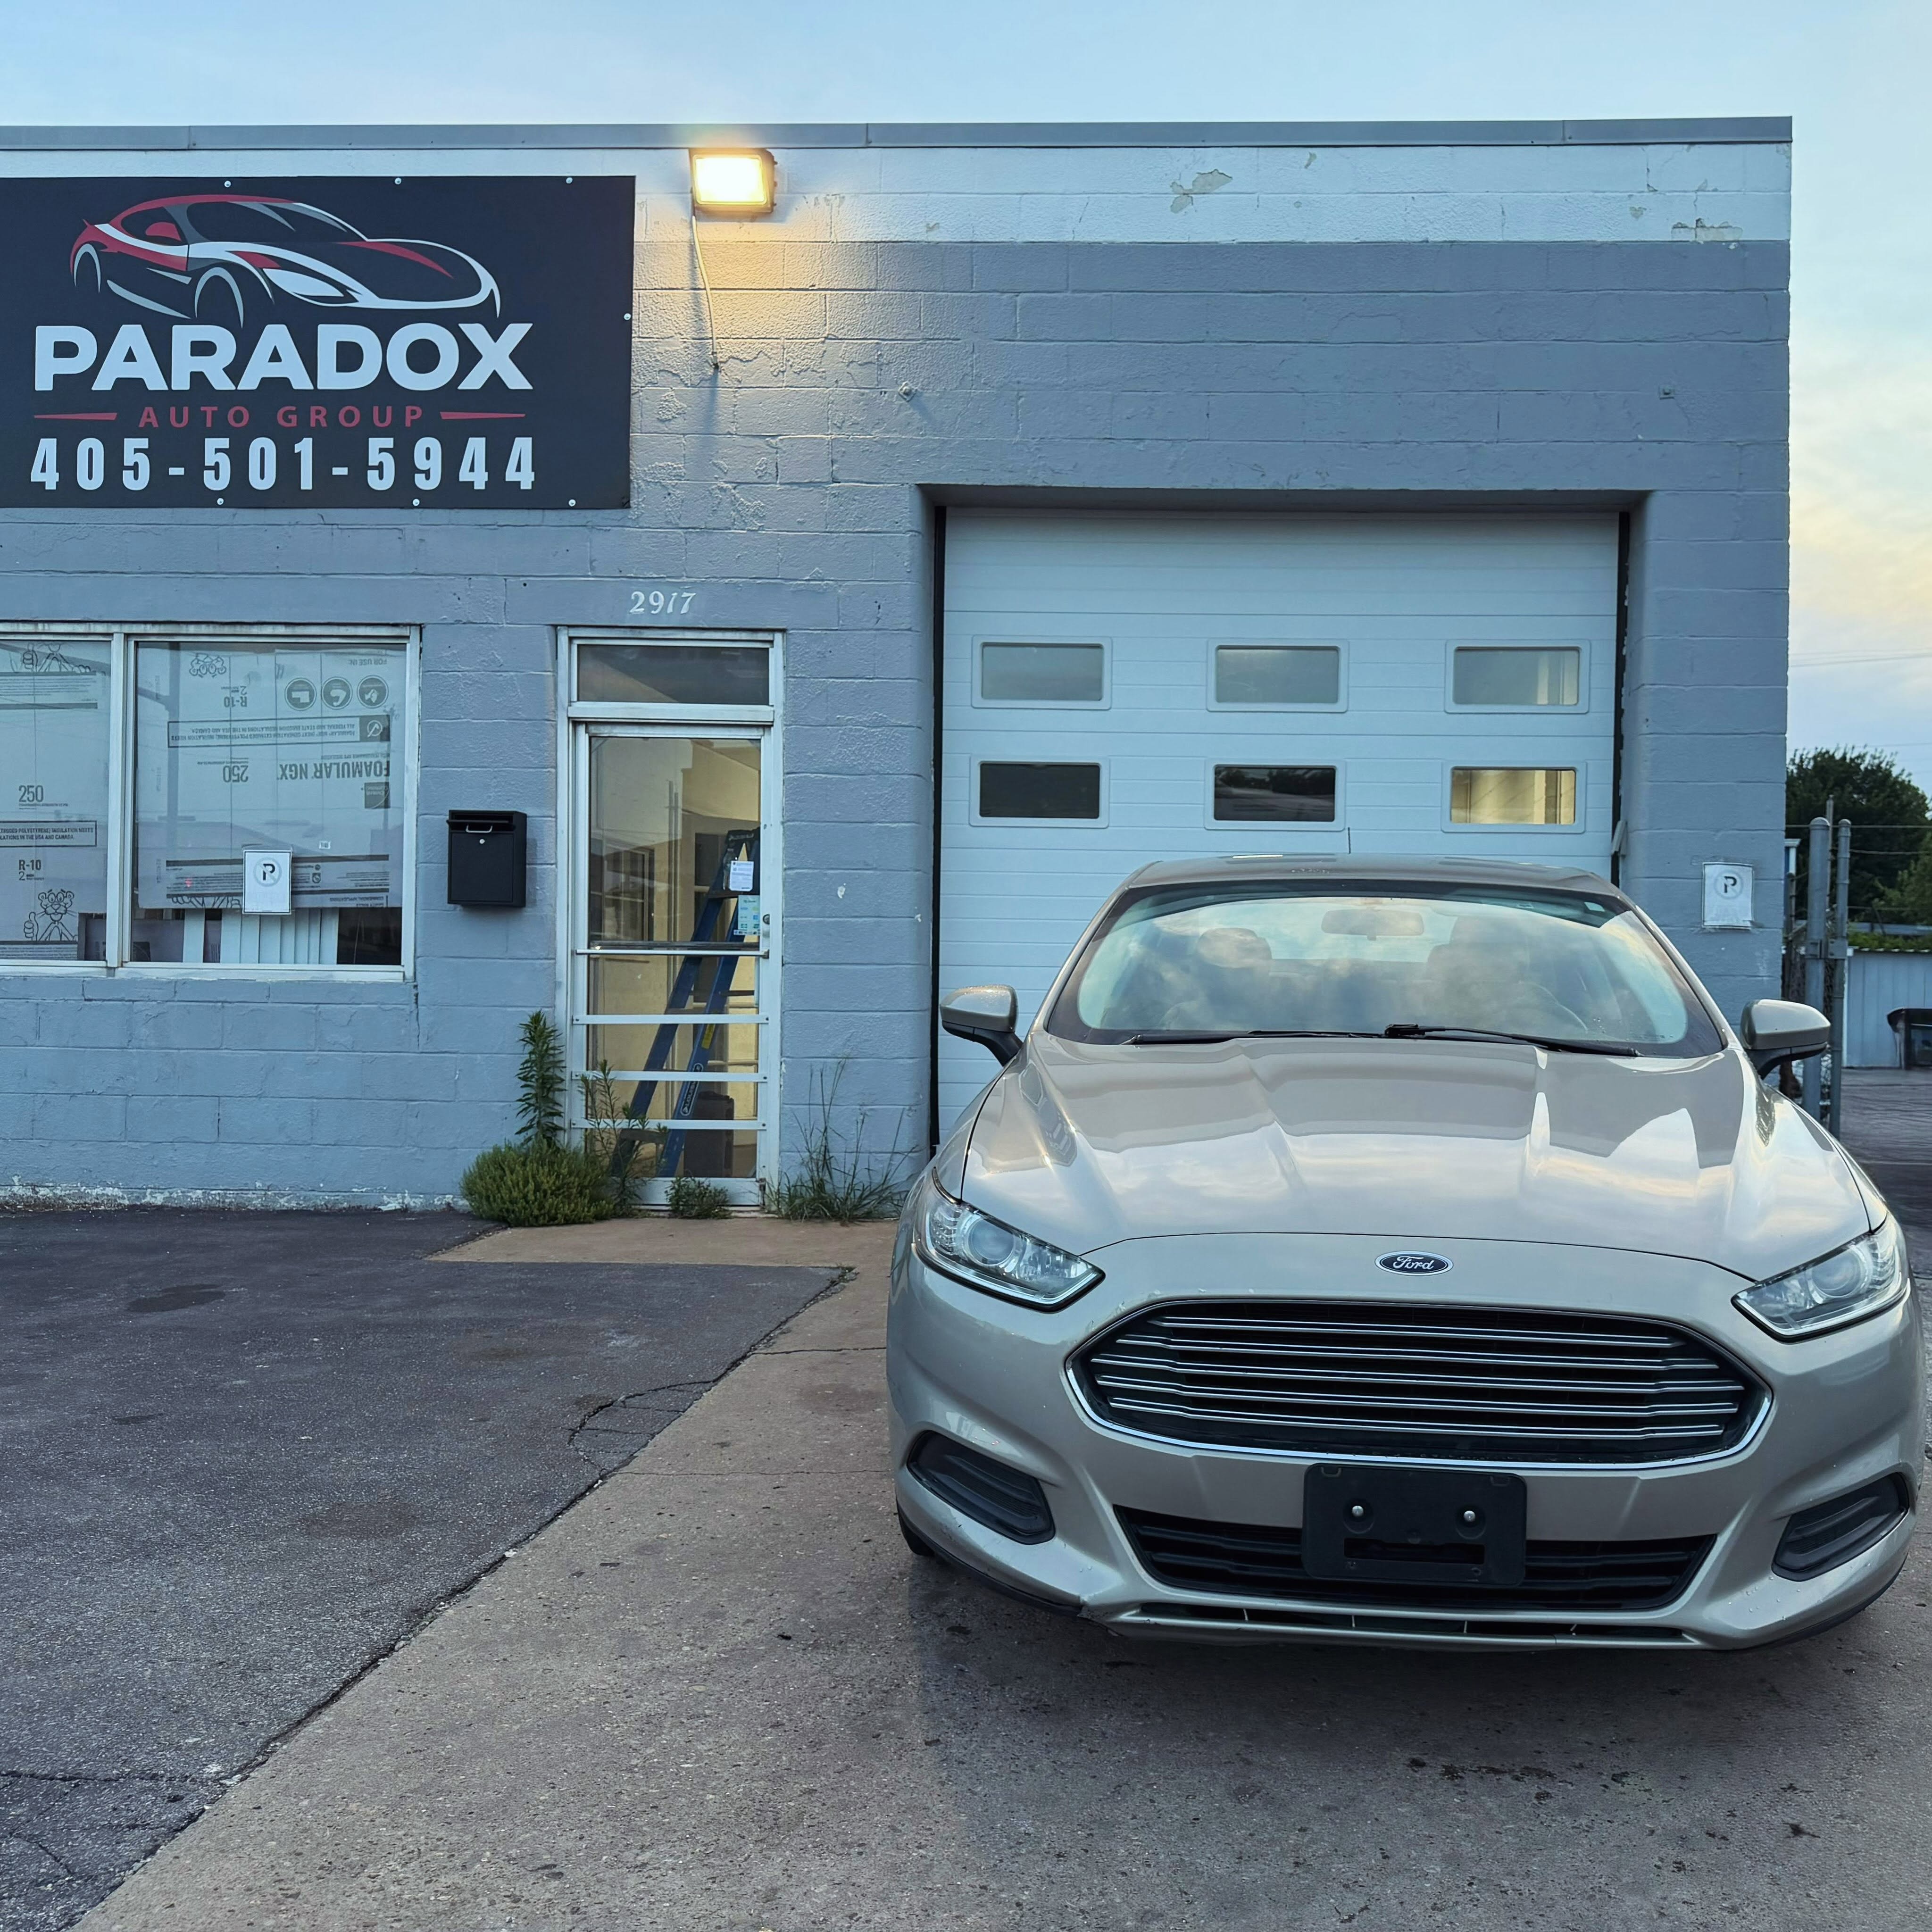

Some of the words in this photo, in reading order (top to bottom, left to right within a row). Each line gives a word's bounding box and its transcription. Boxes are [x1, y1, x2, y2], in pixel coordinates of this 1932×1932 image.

[35, 323, 533, 391] PARADOX
[138, 406, 250, 428] AUTO
[277, 405, 422, 427] GROUP
[31, 437, 535, 491] 405-501-5944
[630, 591, 697, 614] 2917
[240, 686, 248, 696] 2
[224, 696, 248, 708] R-10
[223, 766, 249, 783] 250
[19, 785, 43, 802] 250
[19, 859, 42, 871] R-10
[19, 871, 25, 881] 2
[1393, 1256, 1434, 1269] Ford
